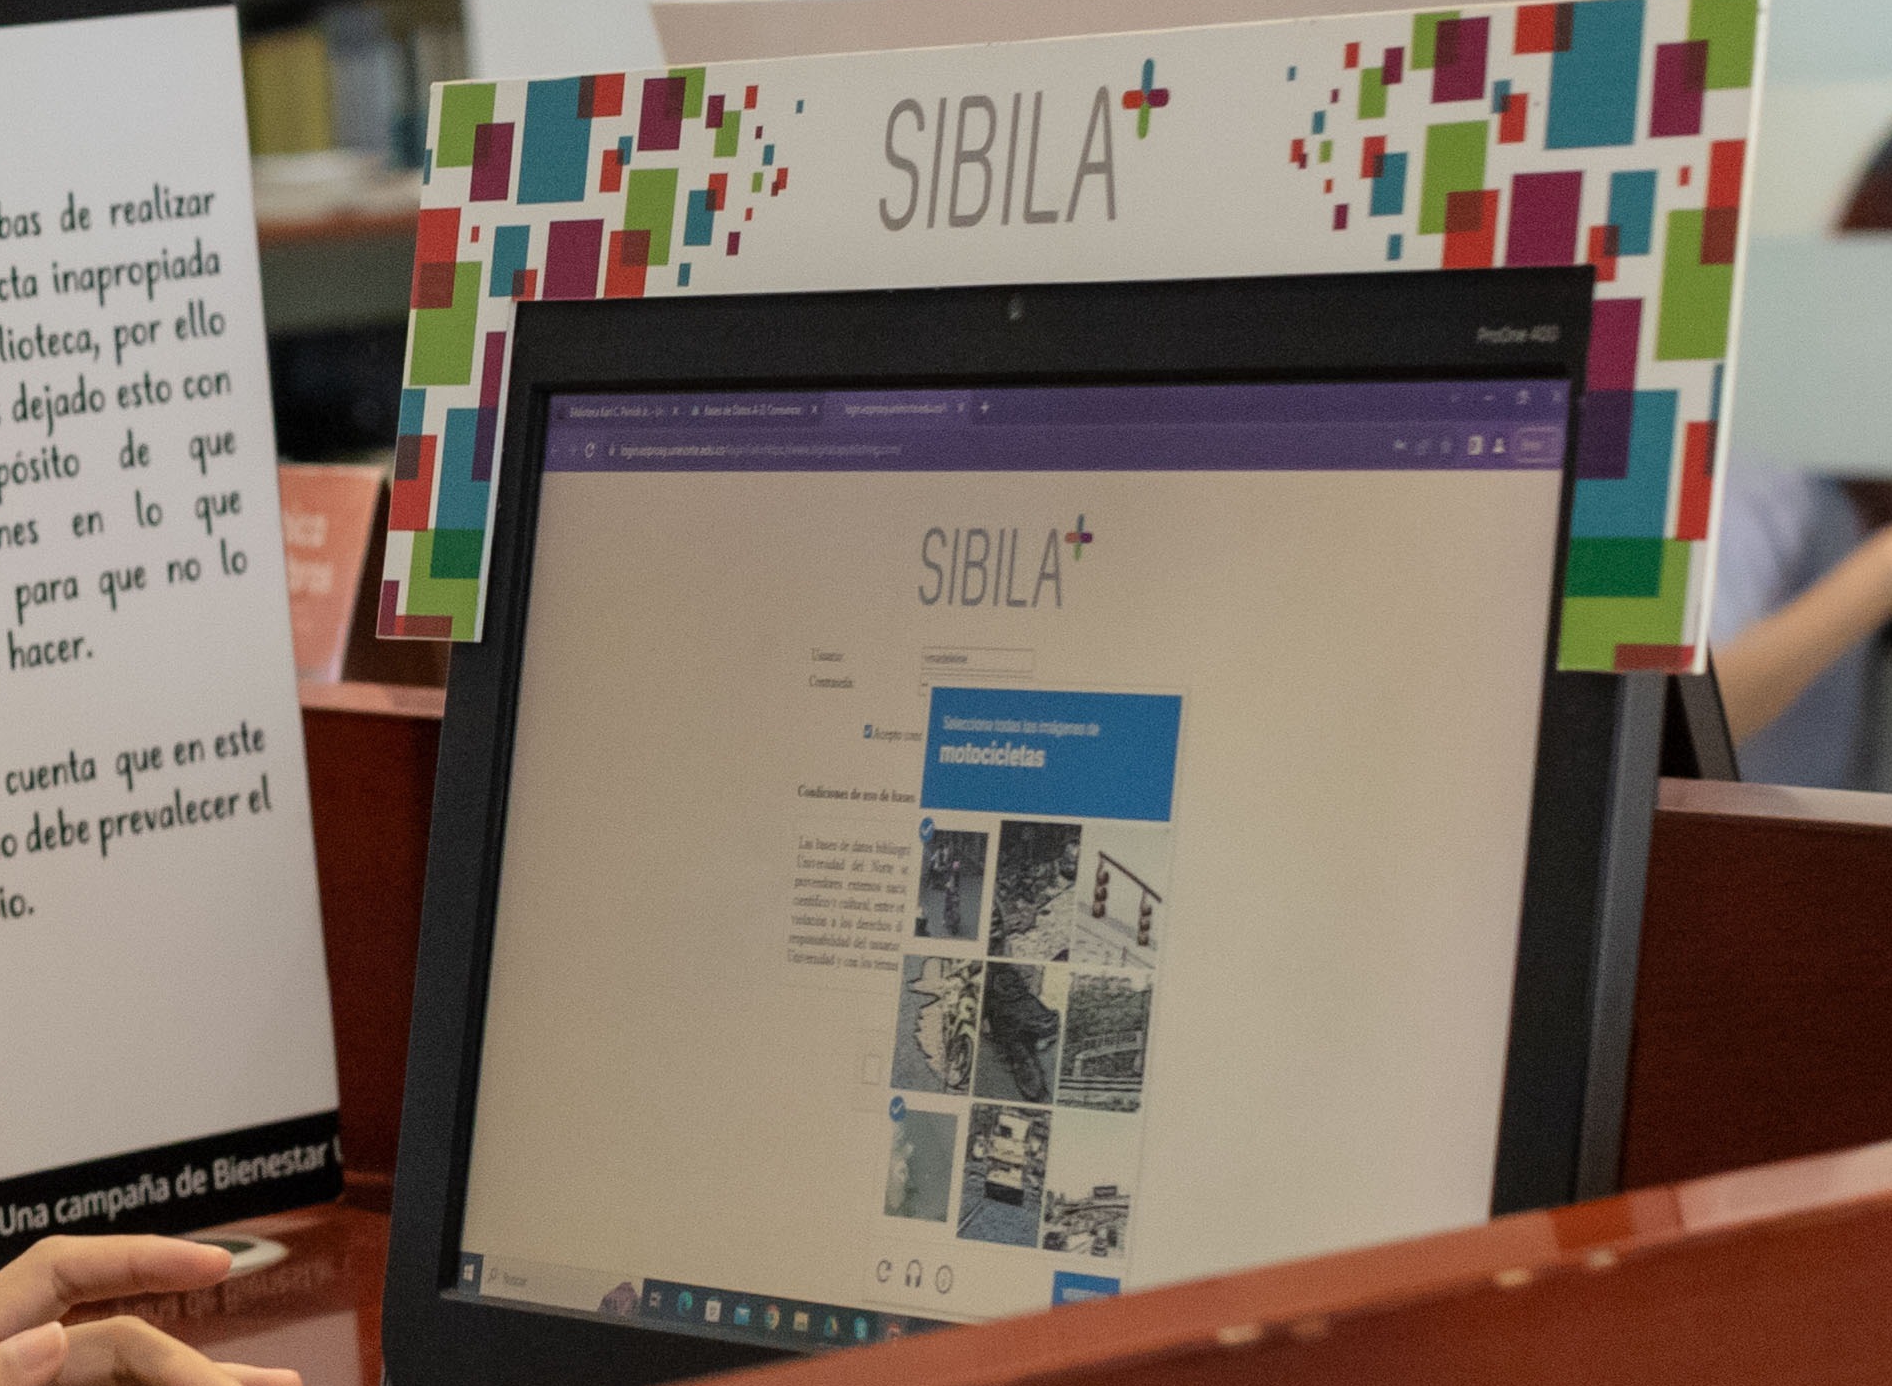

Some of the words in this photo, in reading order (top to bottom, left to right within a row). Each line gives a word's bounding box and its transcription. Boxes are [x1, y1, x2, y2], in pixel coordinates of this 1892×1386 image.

[60, 191, 91, 232] de
[110, 183, 215, 226] realizar
[52, 238, 221, 307] inapropiada
[114, 321, 161, 365] por
[175, 300, 225, 340] ello
[12, 375, 105, 436] dejado
[117, 372, 172, 409] esto
[183, 372, 231, 400] con
[119, 429, 150, 470] de
[189, 432, 235, 475] que
[71, 511, 105, 538] en
[135, 489, 163, 528] lo
[195, 492, 242, 536] que
[15, 577, 79, 625] para
[99, 566, 147, 611] que
[167, 558, 201, 584] no
[220, 538, 247, 576] lo
[7, 631, 93, 670] hacer.
[5, 750, 96, 795] cuenta
[116, 747, 162, 791] que
[173, 739, 205, 766] en
[214, 721, 265, 759] este
[939, 739, 1046, 768] motocicletas
[26, 803, 90, 853] debe
[99, 789, 240, 858] prevalecer
[248, 773, 272, 814] el
[55, 1171, 171, 1223] campaña
[174, 1164, 209, 1199] de
[213, 1143, 329, 1191] Bienestar
